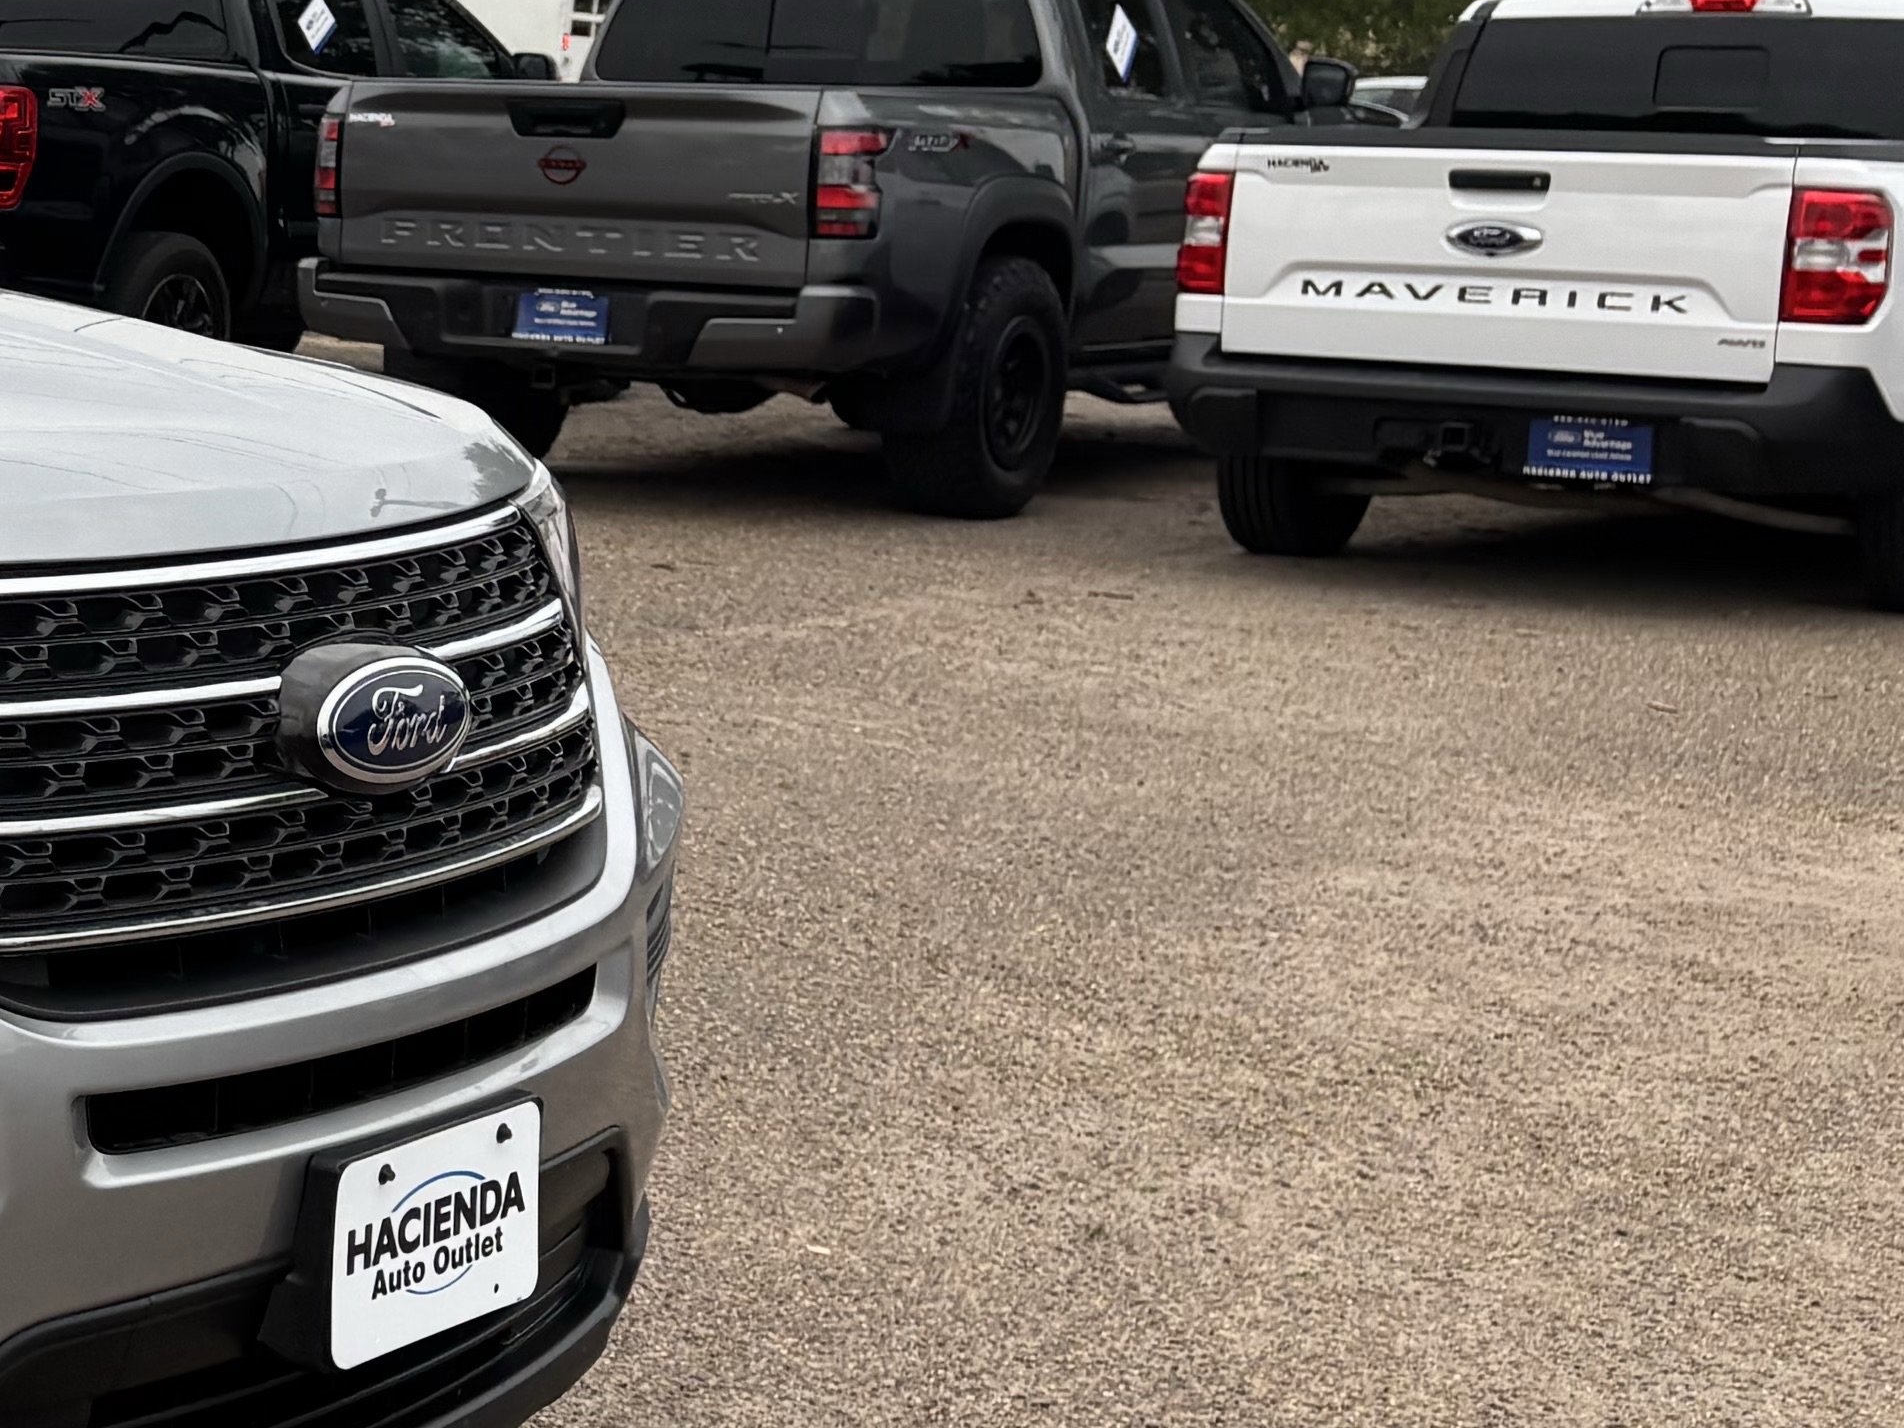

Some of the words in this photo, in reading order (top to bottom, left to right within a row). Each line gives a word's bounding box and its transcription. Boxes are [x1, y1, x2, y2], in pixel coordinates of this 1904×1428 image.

[47, 86, 106, 112] STX
[380, 217, 760, 263] FRONTIER
[1300, 278, 1688, 315] MAVERICK
[367, 683, 448, 756] Ford
[346, 1171, 526, 1276] HACIENDA
[370, 1260, 426, 1300] Auto
[433, 1225, 504, 1276] Outlet
